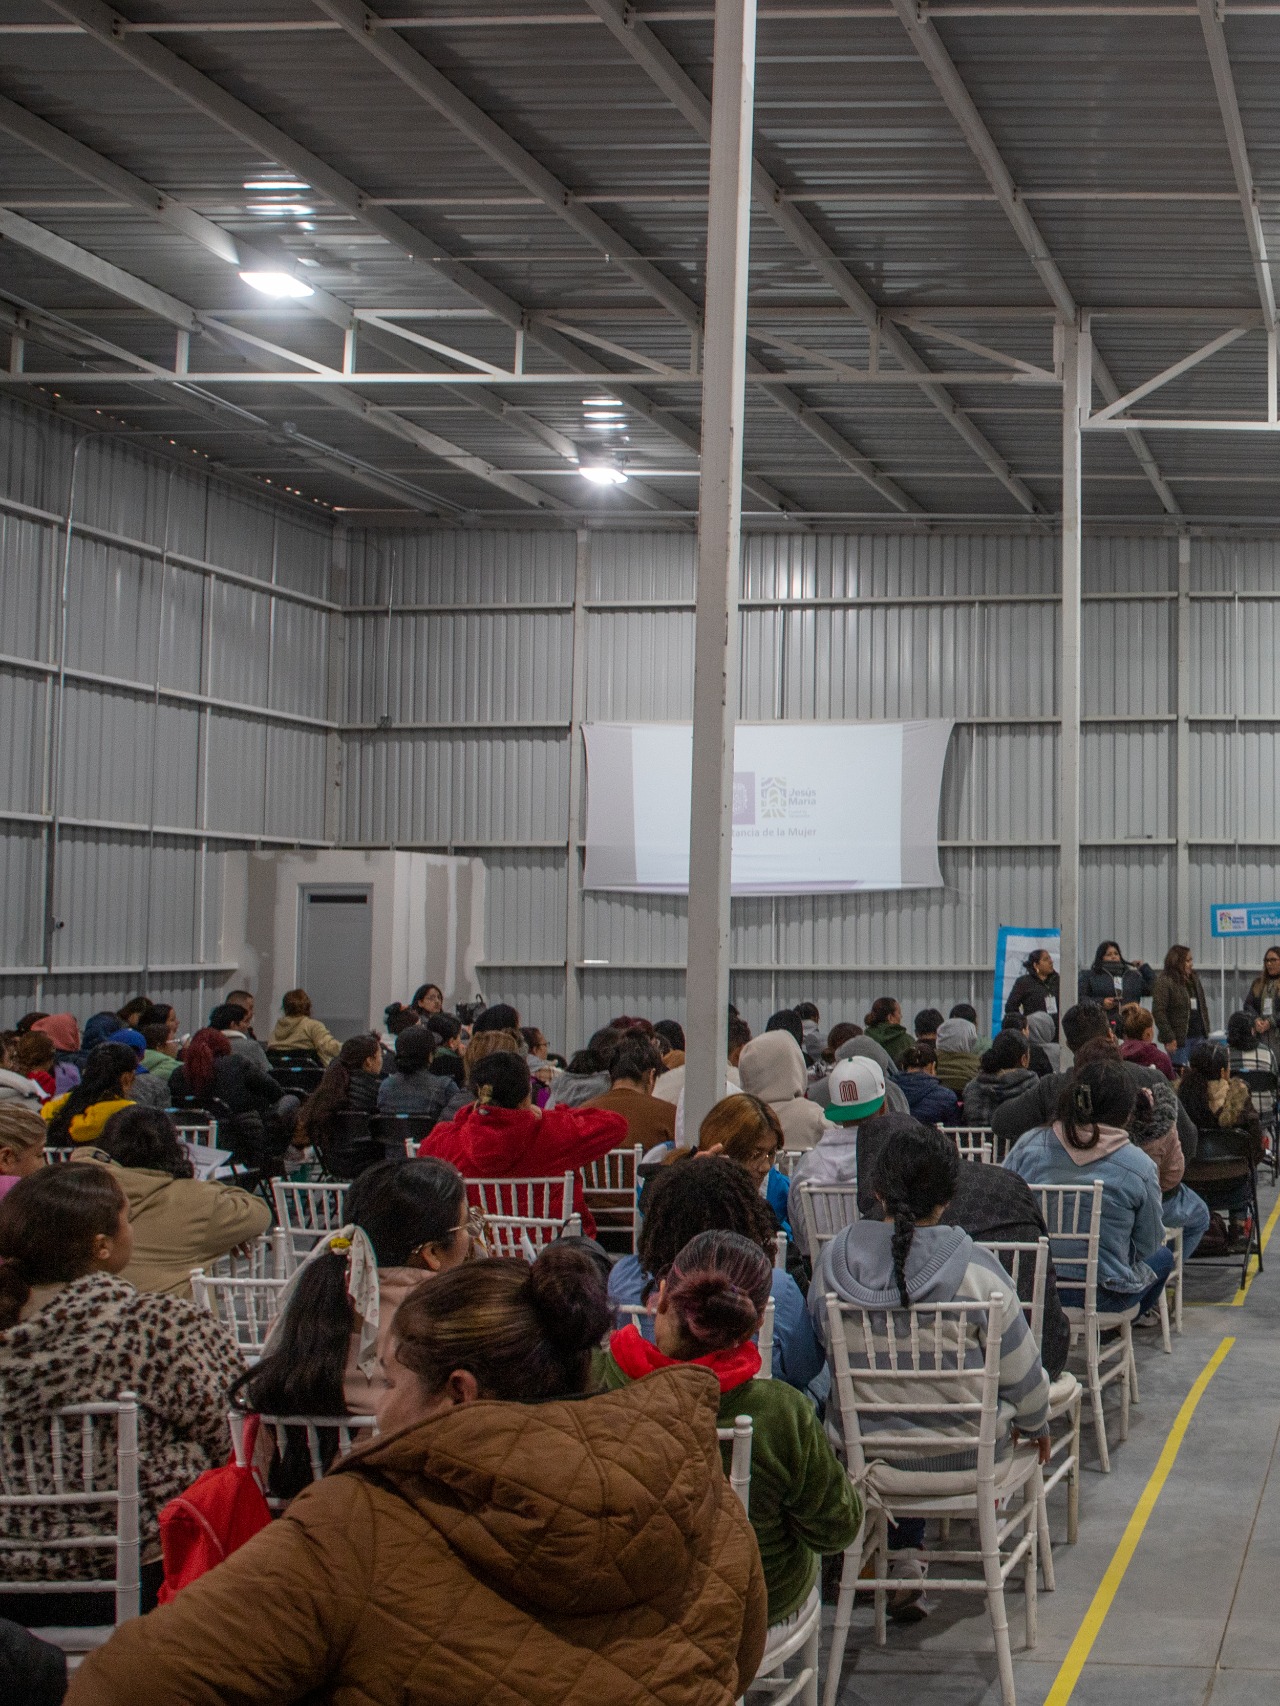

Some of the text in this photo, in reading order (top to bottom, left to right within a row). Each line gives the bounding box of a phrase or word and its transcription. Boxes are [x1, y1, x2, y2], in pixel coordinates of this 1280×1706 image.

[762, 827, 775, 837] de
[777, 827, 786, 837] la
[788, 827, 817, 838] Mujer
